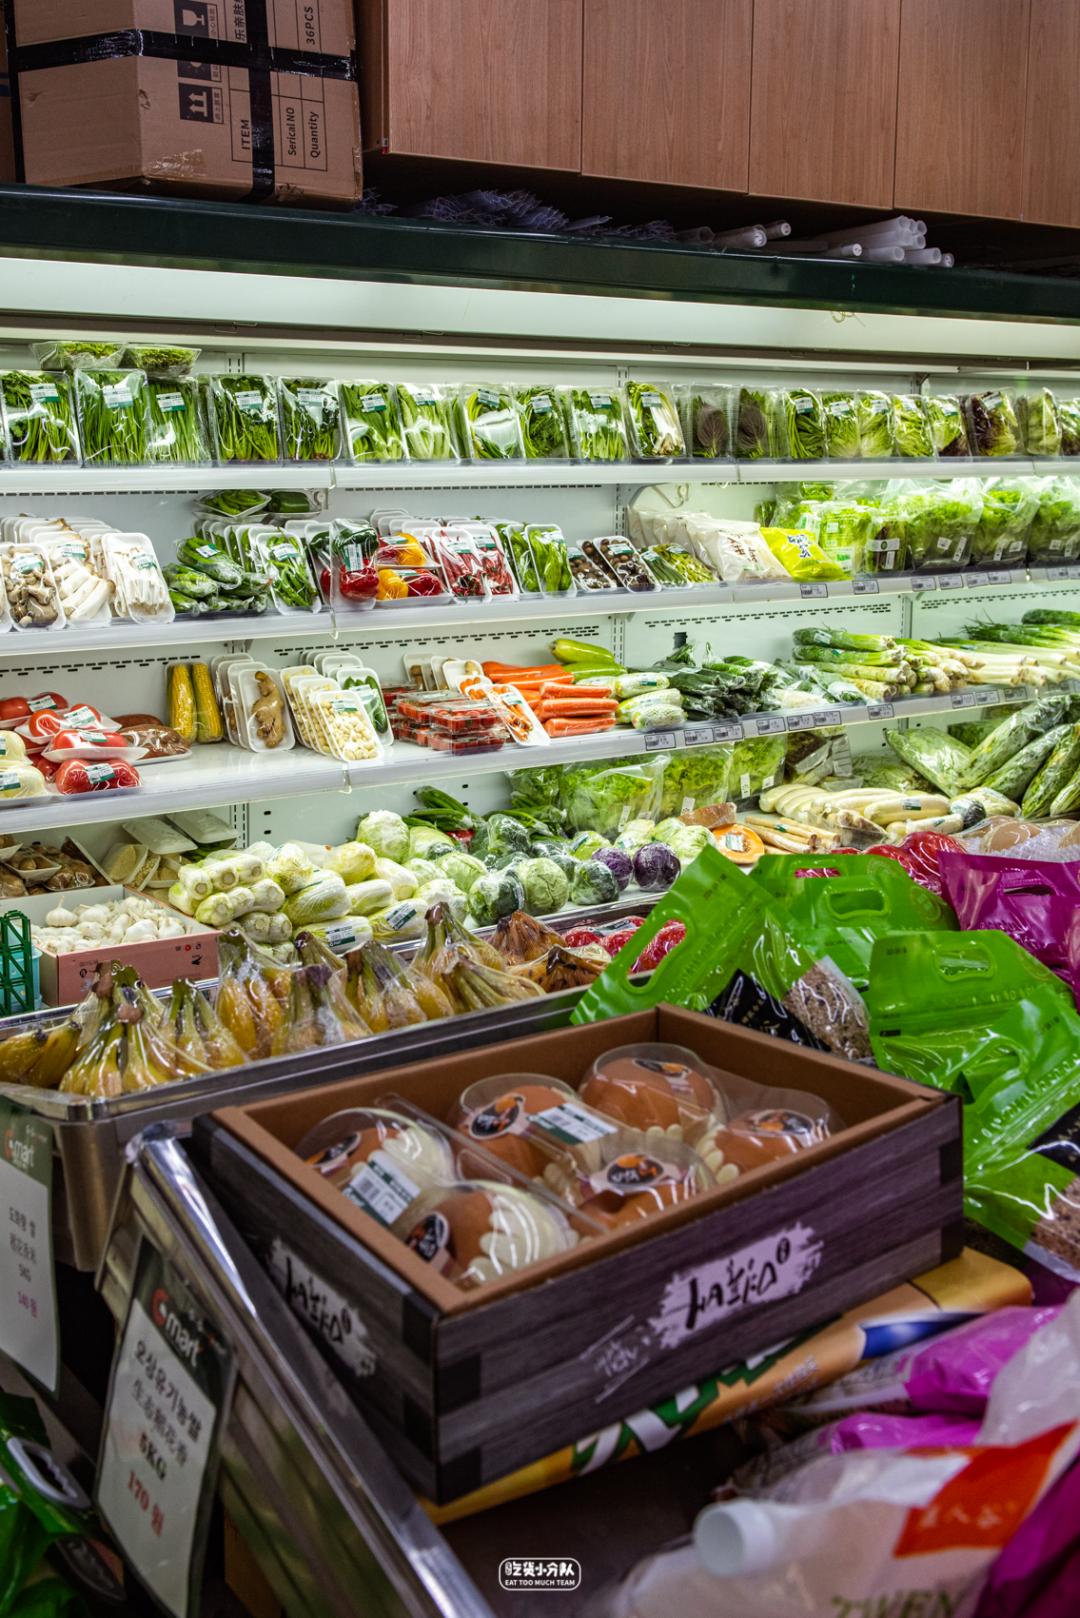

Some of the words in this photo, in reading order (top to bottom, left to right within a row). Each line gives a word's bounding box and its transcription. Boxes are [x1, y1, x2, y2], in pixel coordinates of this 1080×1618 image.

[304, 6, 315, 45] 36PCS
[287, 107, 295, 121] NO
[241, 119, 250, 150] ITEM
[287, 122, 297, 156] Serical
[310, 112, 320, 158] Quantity
[139, 1431, 167, 1480] 5KG
